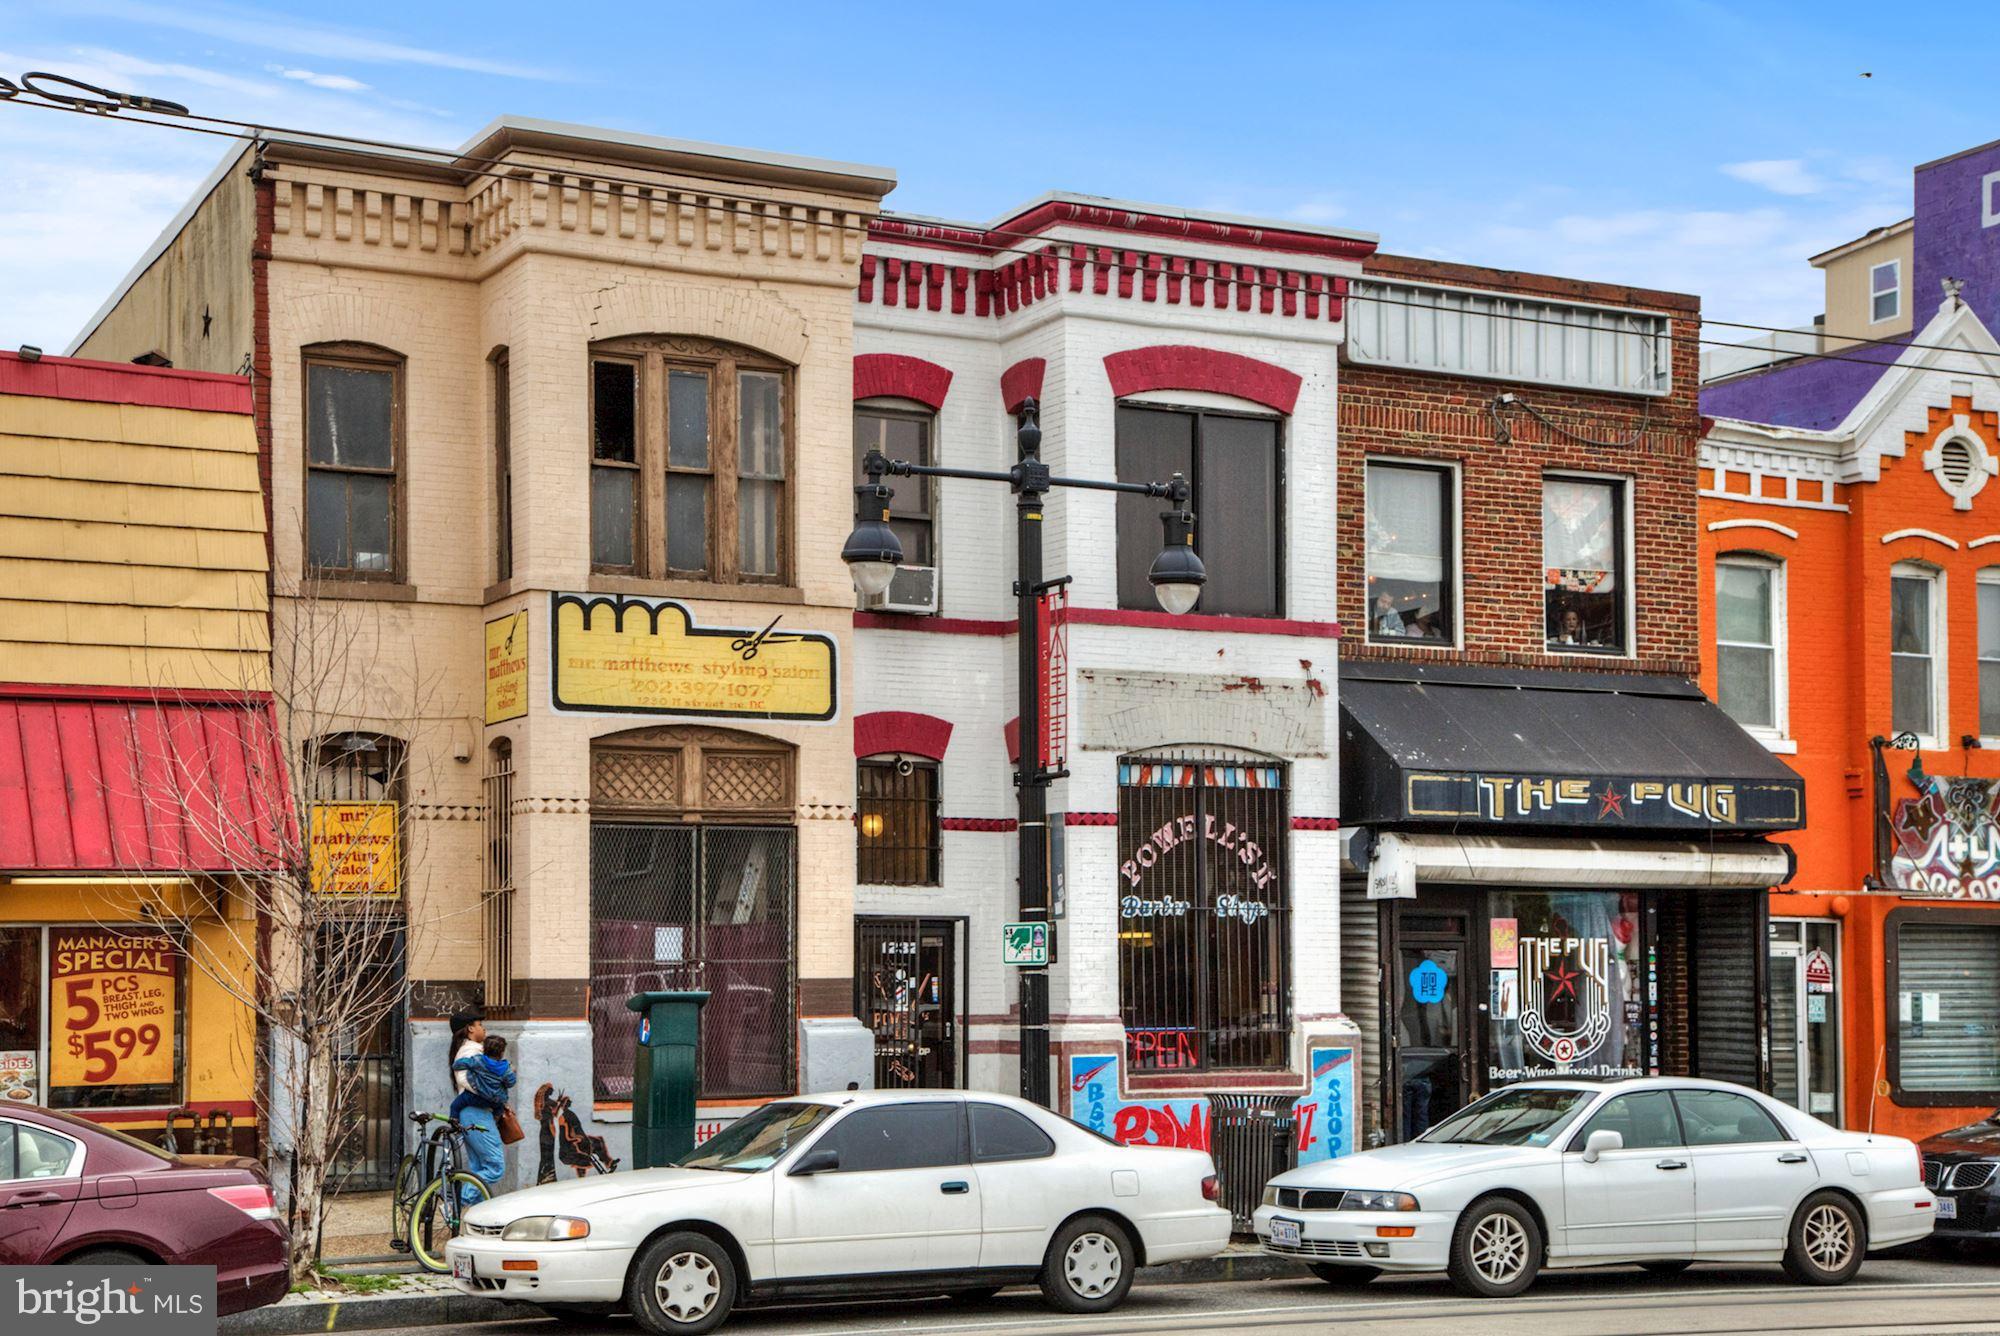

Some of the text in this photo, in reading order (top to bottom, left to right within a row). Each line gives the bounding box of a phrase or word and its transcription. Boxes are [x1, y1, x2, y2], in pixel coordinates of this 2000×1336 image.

[489, 646, 502, 661] mr.
[489, 657, 526, 680] matthews
[604, 656, 693, 674] matthews
[702, 660, 768, 680] styling
[772, 665, 820, 680] salon
[496, 680, 518, 698] styling
[497, 697, 516, 711] salon
[1479, 777, 1737, 826] THE PUG
[1120, 814, 1262, 887] POWELL'S
[1121, 893, 1269, 925] Barber Shop
[58, 936, 170, 951] MANAGER'S
[58, 950, 169, 974] SPECIAL
[65, 975, 139, 1031] 5 PCS
[102, 988, 165, 1003] BREAST, LEG,
[103, 1000, 155, 1013] THIGH AND
[104, 1005, 165, 1021] TWO WINGS
[1600, 1064, 1643, 1077] Drinks
[1327, 1078, 1343, 1159] SHOP
